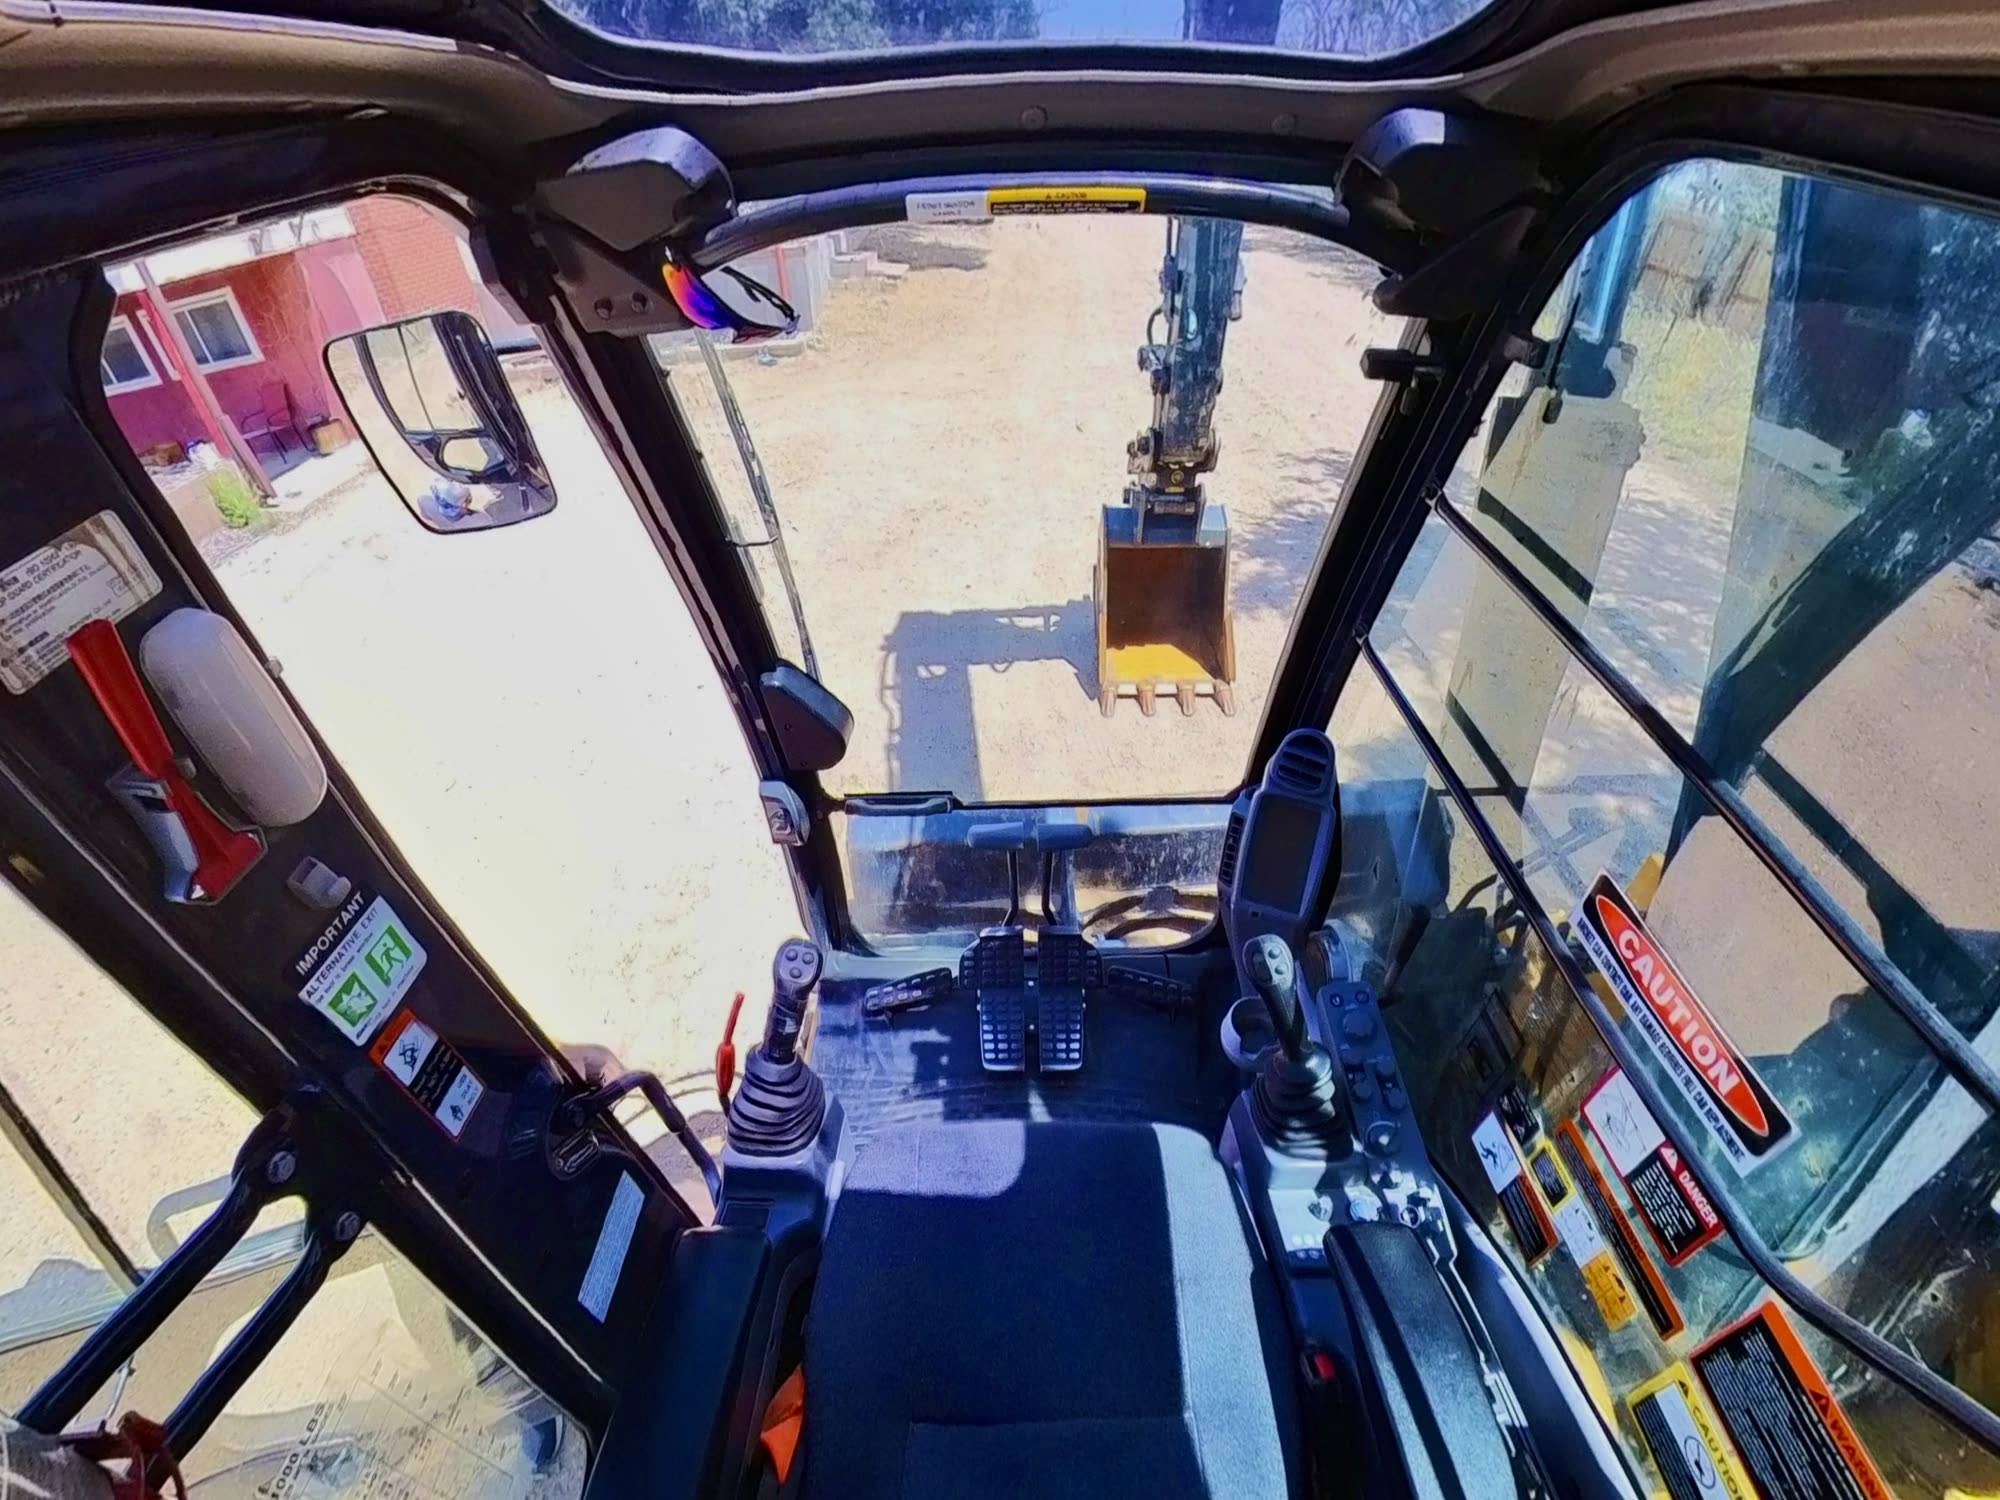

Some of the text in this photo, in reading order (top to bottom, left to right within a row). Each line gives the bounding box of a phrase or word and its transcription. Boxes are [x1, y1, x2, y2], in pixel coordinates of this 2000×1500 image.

[296, 892, 365, 976] IMPORTANT
[306, 907, 378, 999] ALTERNATIVE EXIT
[1618, 927, 1741, 1097] CAUTION
[1679, 1170, 1718, 1229] DANGER
[299, 1403, 326, 1446] LBS
[1693, 1406, 1744, 1500] CAUTIO
